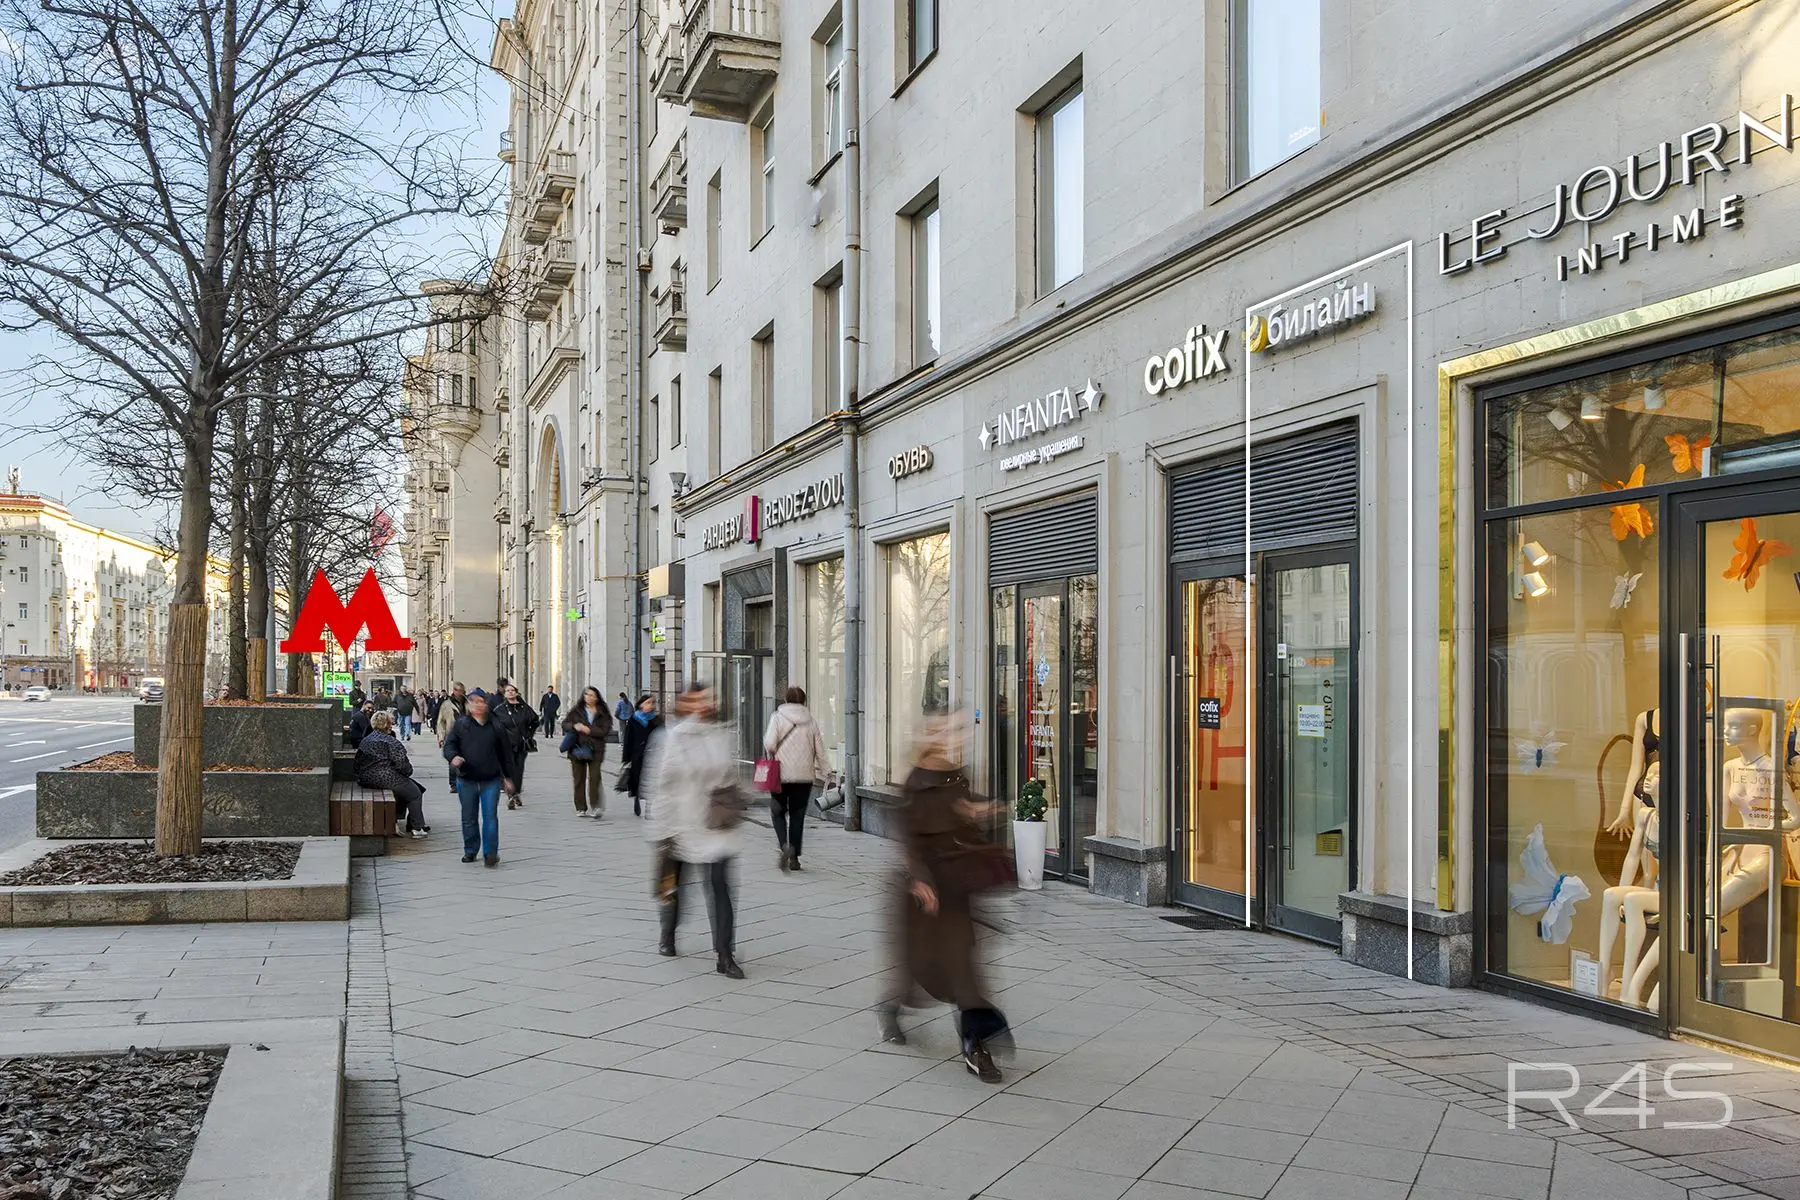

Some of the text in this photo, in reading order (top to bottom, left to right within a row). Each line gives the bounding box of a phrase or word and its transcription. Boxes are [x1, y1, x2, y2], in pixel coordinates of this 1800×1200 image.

[1438, 209, 1507, 276] LE
[1557, 194, 1744, 282] INTIME
[1267, 279, 1376, 347] билайн
[1144, 324, 1229, 395] cofix
[997, 386, 1075, 446] INFANTA
[888, 444, 931, 479] ОБУВЬ
[703, 513, 743, 551] РАНДЕВУ
[1200, 700, 1219, 713] cofix
